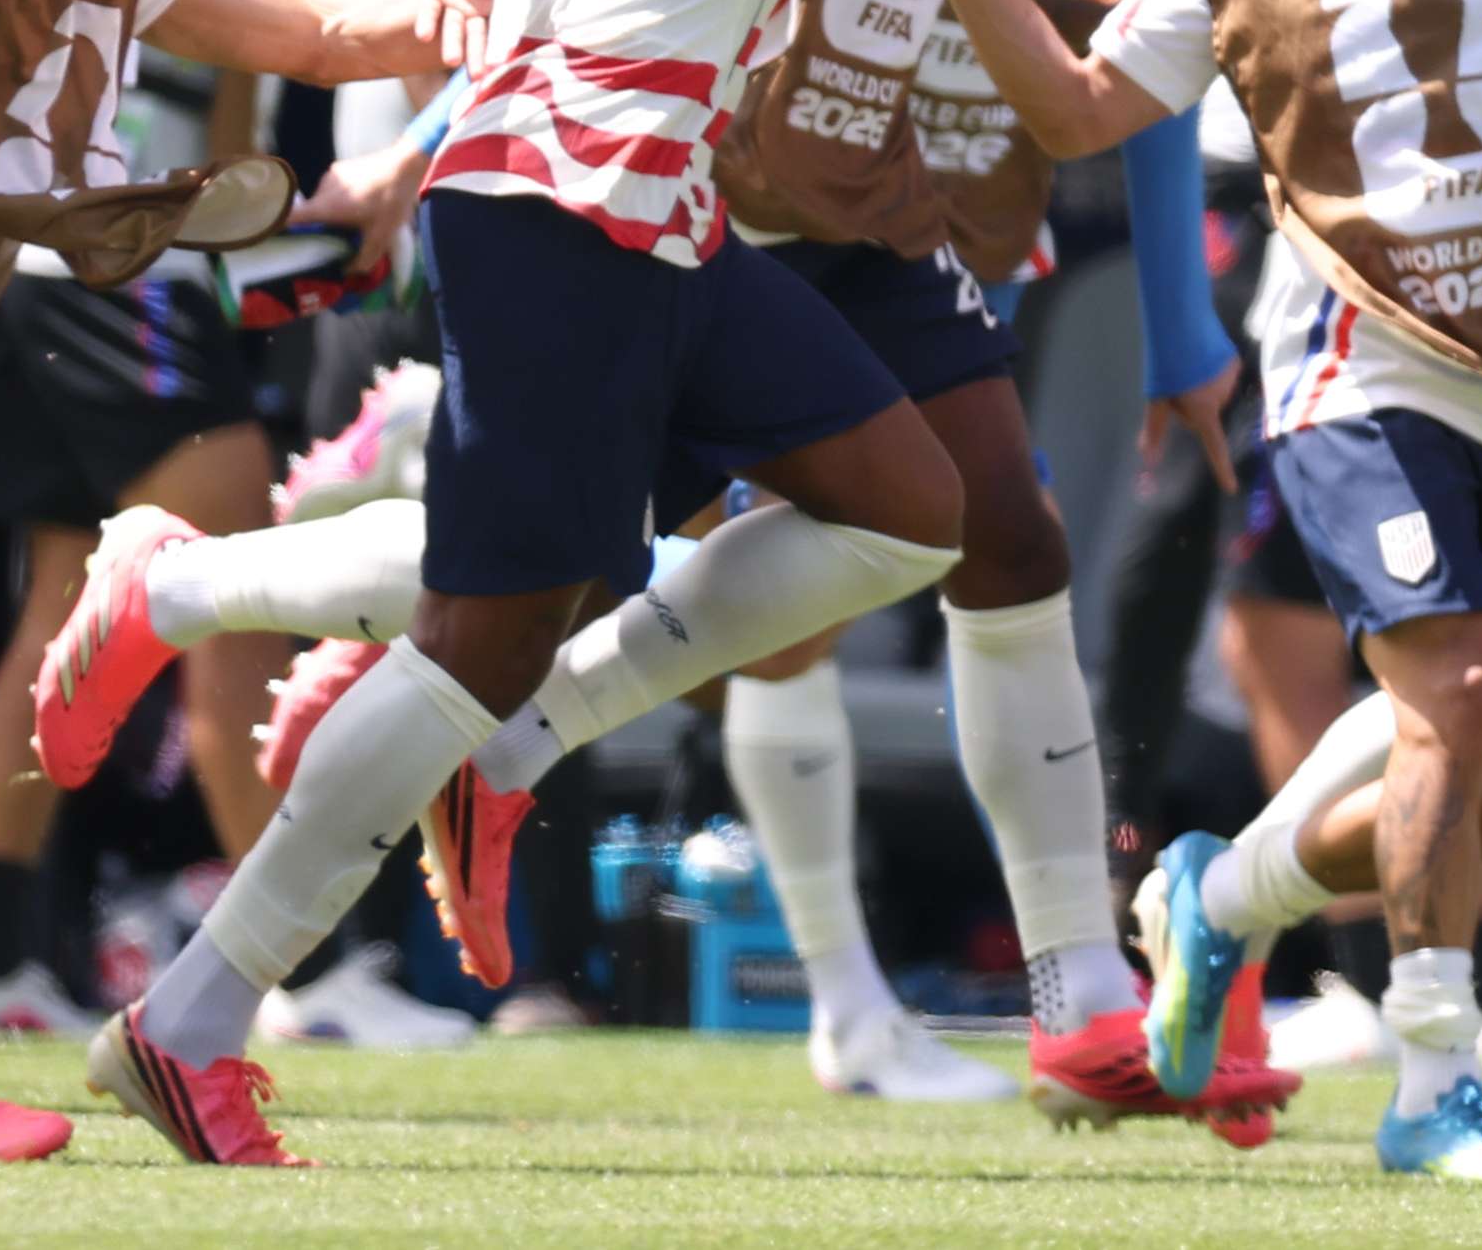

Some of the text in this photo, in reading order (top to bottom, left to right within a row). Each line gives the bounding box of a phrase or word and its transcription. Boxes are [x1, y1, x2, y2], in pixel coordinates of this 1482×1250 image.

[856, 0, 913, 42] FIFA
[807, 53, 879, 102] WORLD
[786, 86, 894, 151] 2026
